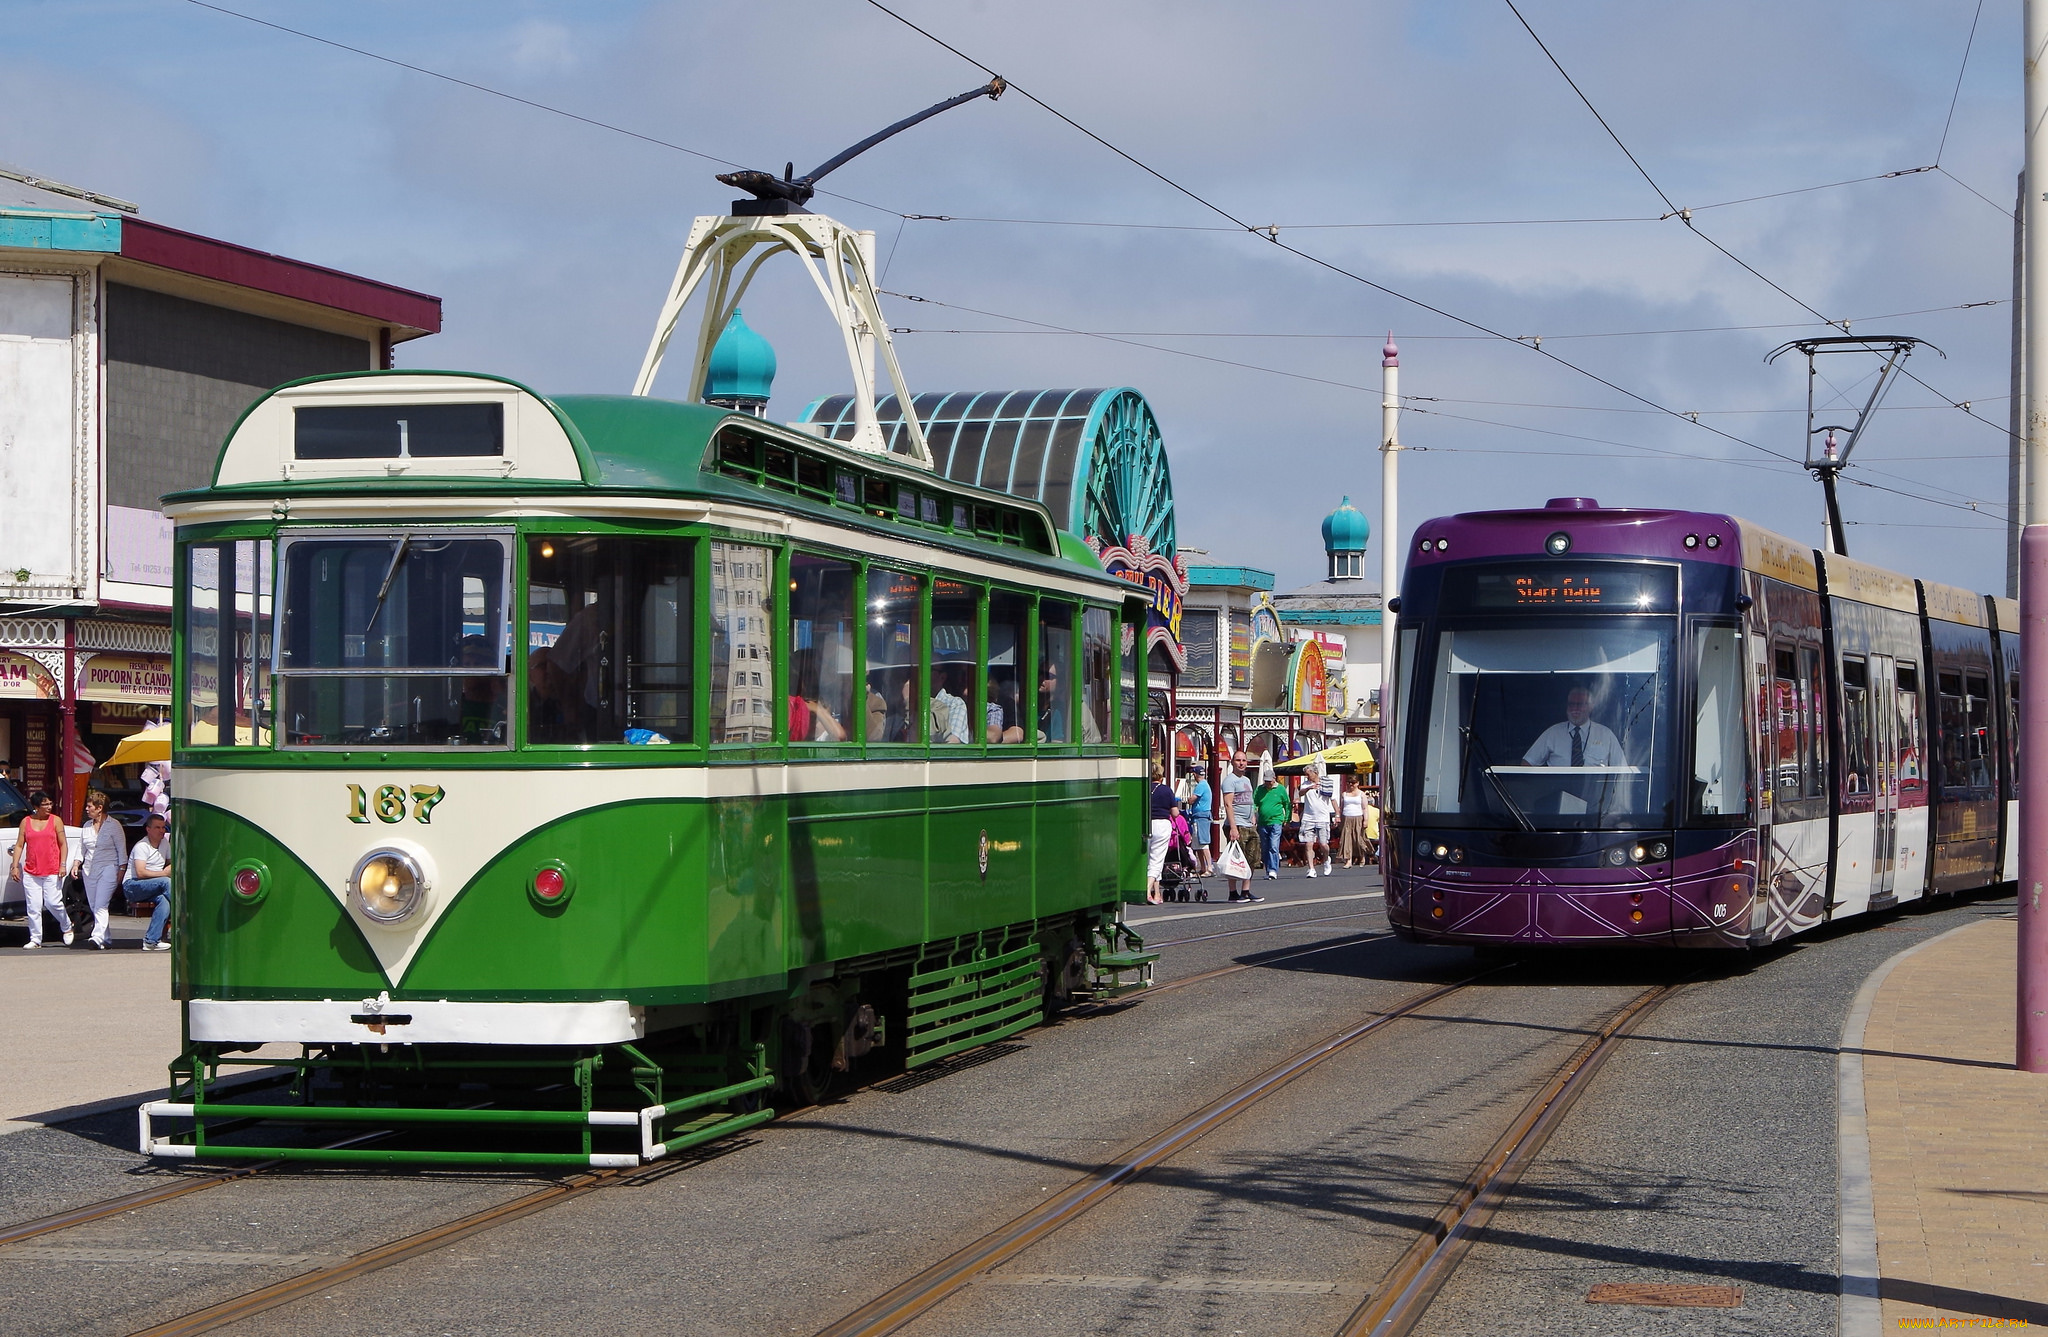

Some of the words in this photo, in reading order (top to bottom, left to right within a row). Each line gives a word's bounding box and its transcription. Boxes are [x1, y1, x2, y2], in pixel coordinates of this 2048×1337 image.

[396, 419, 412, 458] 1
[91, 668, 132, 685] POPCORN
[135, 671, 141, 685] &
[144, 672, 172, 687] CANDY
[121, 684, 131, 693] HOT
[138, 686, 152, 694] COLD
[345, 783, 446, 824] 167
[1713, 903, 1727, 918] 005
